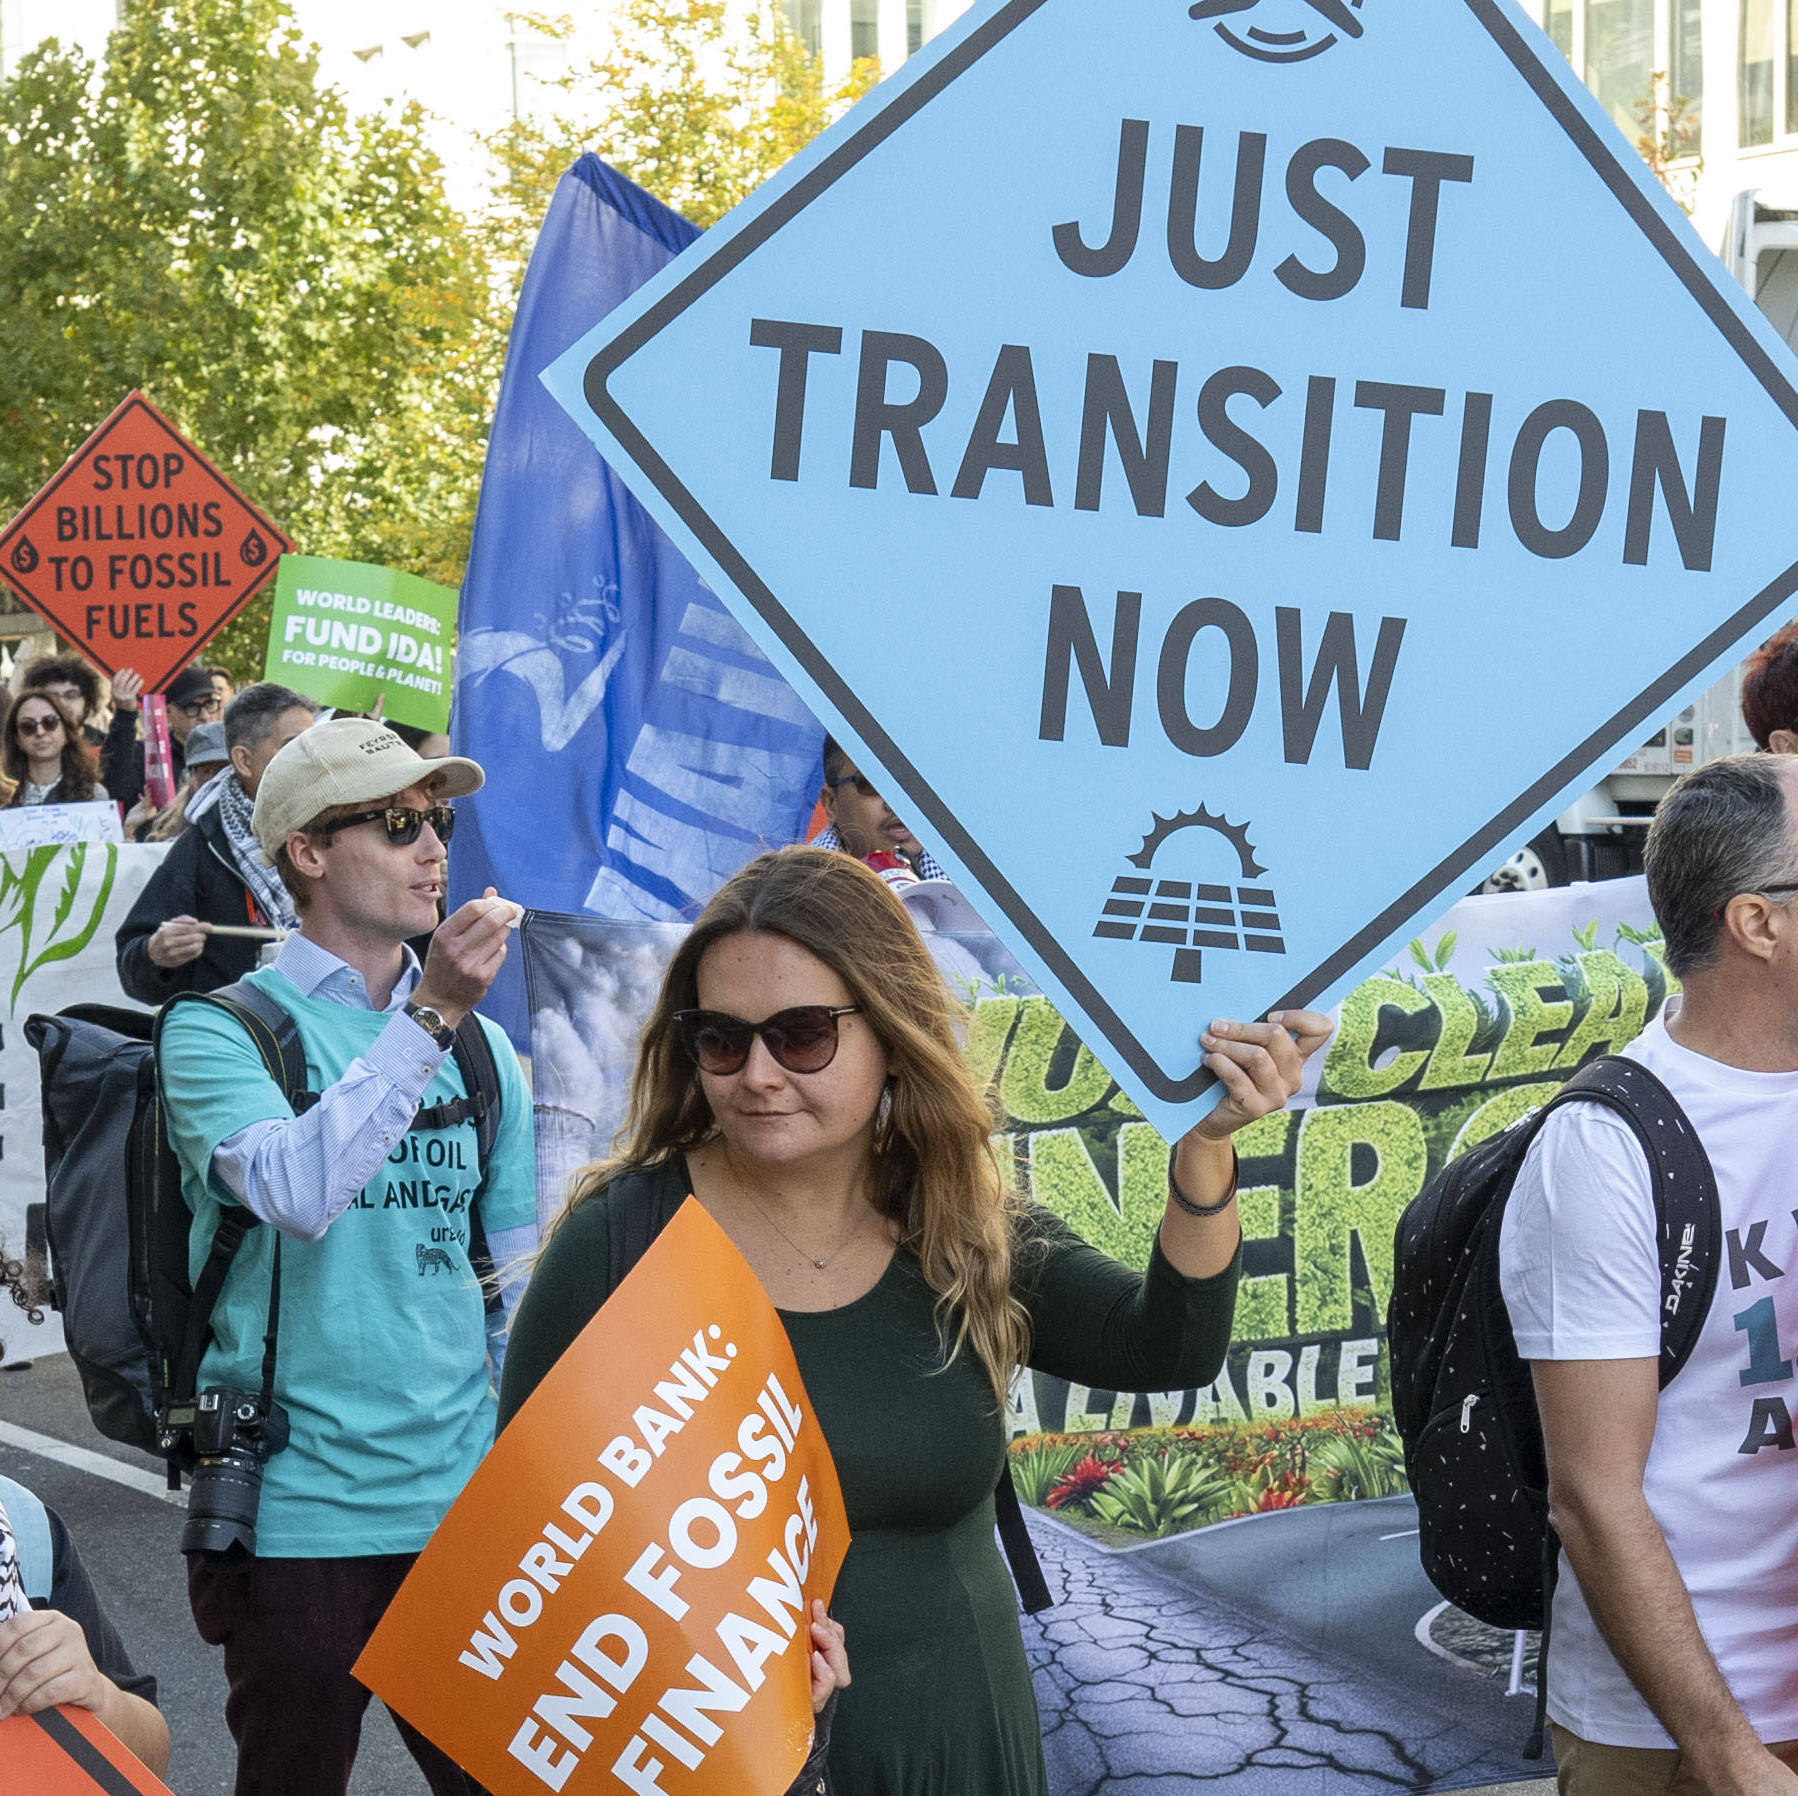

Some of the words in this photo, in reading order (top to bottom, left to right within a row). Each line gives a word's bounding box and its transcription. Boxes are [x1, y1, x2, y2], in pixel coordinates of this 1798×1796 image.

[1051, 116, 1474, 310] JUST
[748, 315, 1728, 573] TRANSITION
[92, 452, 185, 492] STOP
[56, 501, 223, 543] BILLIONS
[48, 555, 95, 592] TO
[108, 551, 232, 591] FOSSIL
[86, 602, 198, 641] FUELS
[296, 588, 371, 614] WORLD
[373, 600, 442, 636] LEADERS:
[284, 615, 383, 655] FUND
[386, 632, 443, 674] IDA!
[282, 649, 316, 666] FOR
[318, 653, 375, 678] PEOPLE
[386, 668, 443, 695] PLANET!
[1037, 582, 1409, 773] NOW
[426, 1138, 467, 1171] OIL
[1664, 1223, 1696, 1316] DAKINE
[457, 1480, 615, 1682] WORLD
[596, 1322, 739, 1491] BANK:
[506, 1612, 651, 1794] END
[622, 1370, 805, 1624] FOSSIL
